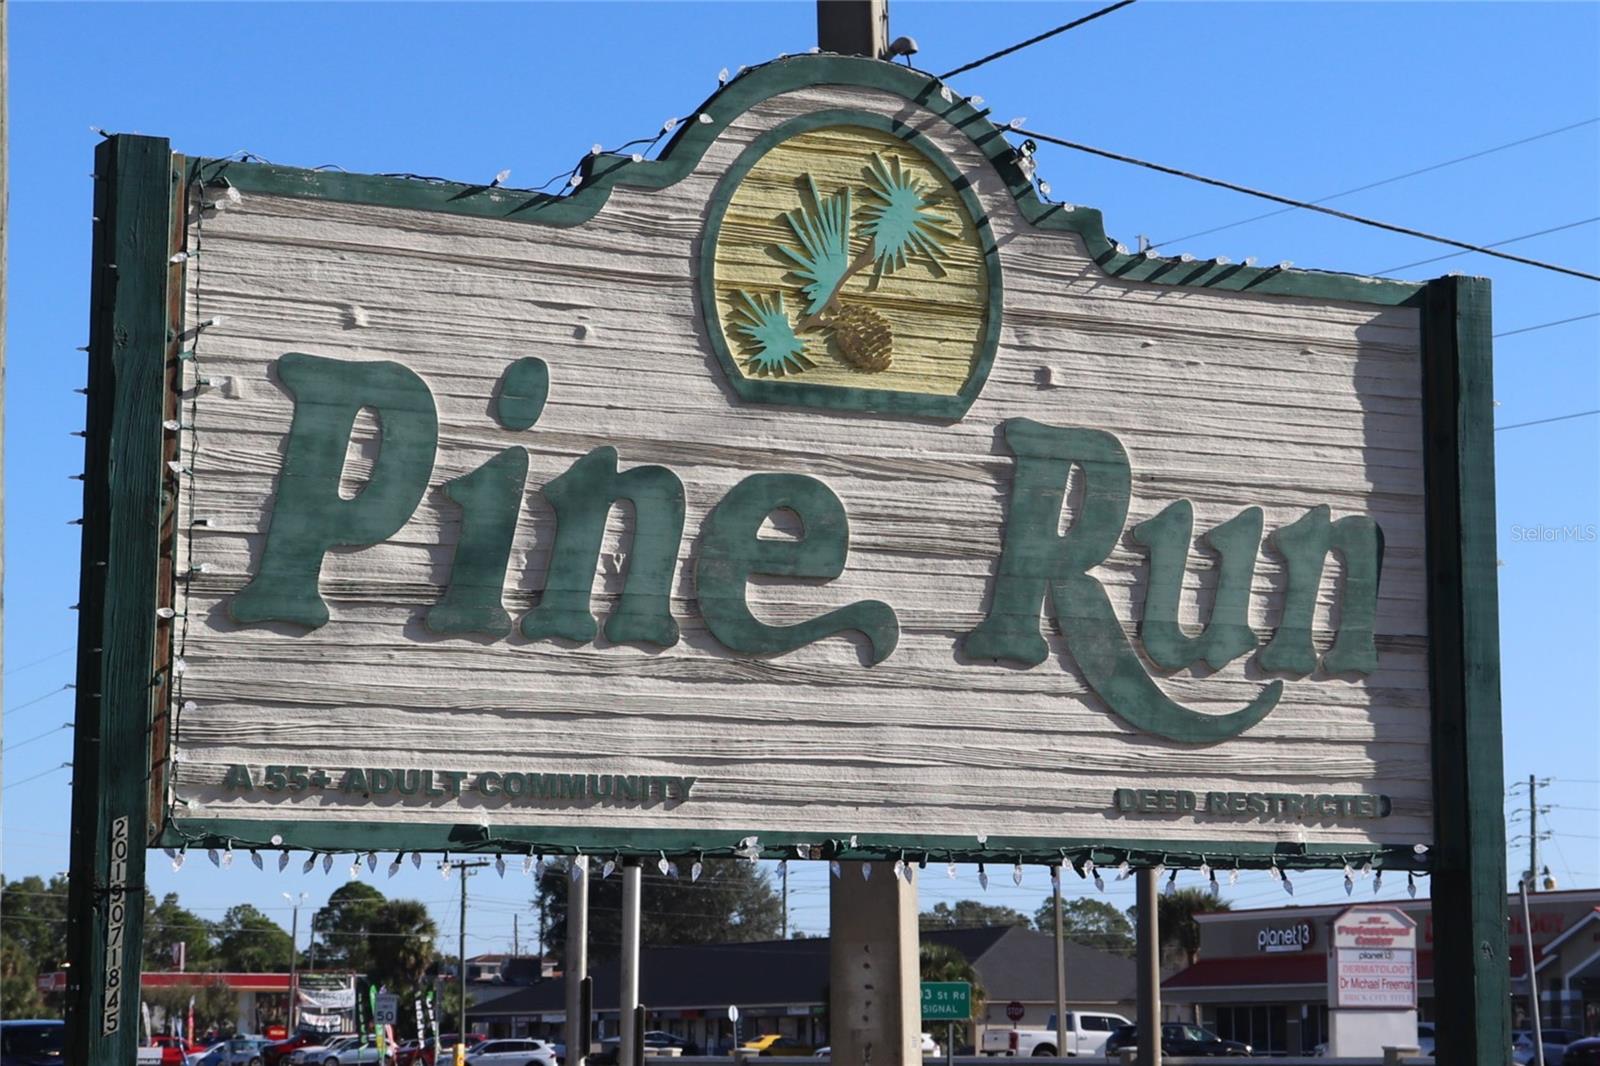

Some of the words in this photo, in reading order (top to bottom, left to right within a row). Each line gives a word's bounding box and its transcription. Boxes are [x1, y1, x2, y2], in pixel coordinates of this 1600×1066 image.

[227, 353, 900, 667] Pine
[961, 417, 1384, 745] Run
[226, 764, 255, 790] A
[264, 766, 332, 793] 55+
[344, 768, 471, 797] ADULT
[477, 771, 697, 800] COMMUNITY
[1114, 787, 1196, 813] DEED
[1205, 791, 1392, 818] RESTRICTED
[1258, 925, 1297, 951] planet
[1298, 924, 1310, 944] 13
[1342, 965, 1411, 975] DERMATOLOGY
[1340, 978, 1349, 989] Dr
[1351, 979, 1380, 990] Michael
[1382, 979, 1414, 990] Freeman
[937, 991, 948, 1000] St
[953, 991, 966, 1000] Rd
[922, 1004, 958, 1014] SIGNAL
[1007, 1006, 1024, 1015] STOP
[376, 1011, 394, 1021] 50
